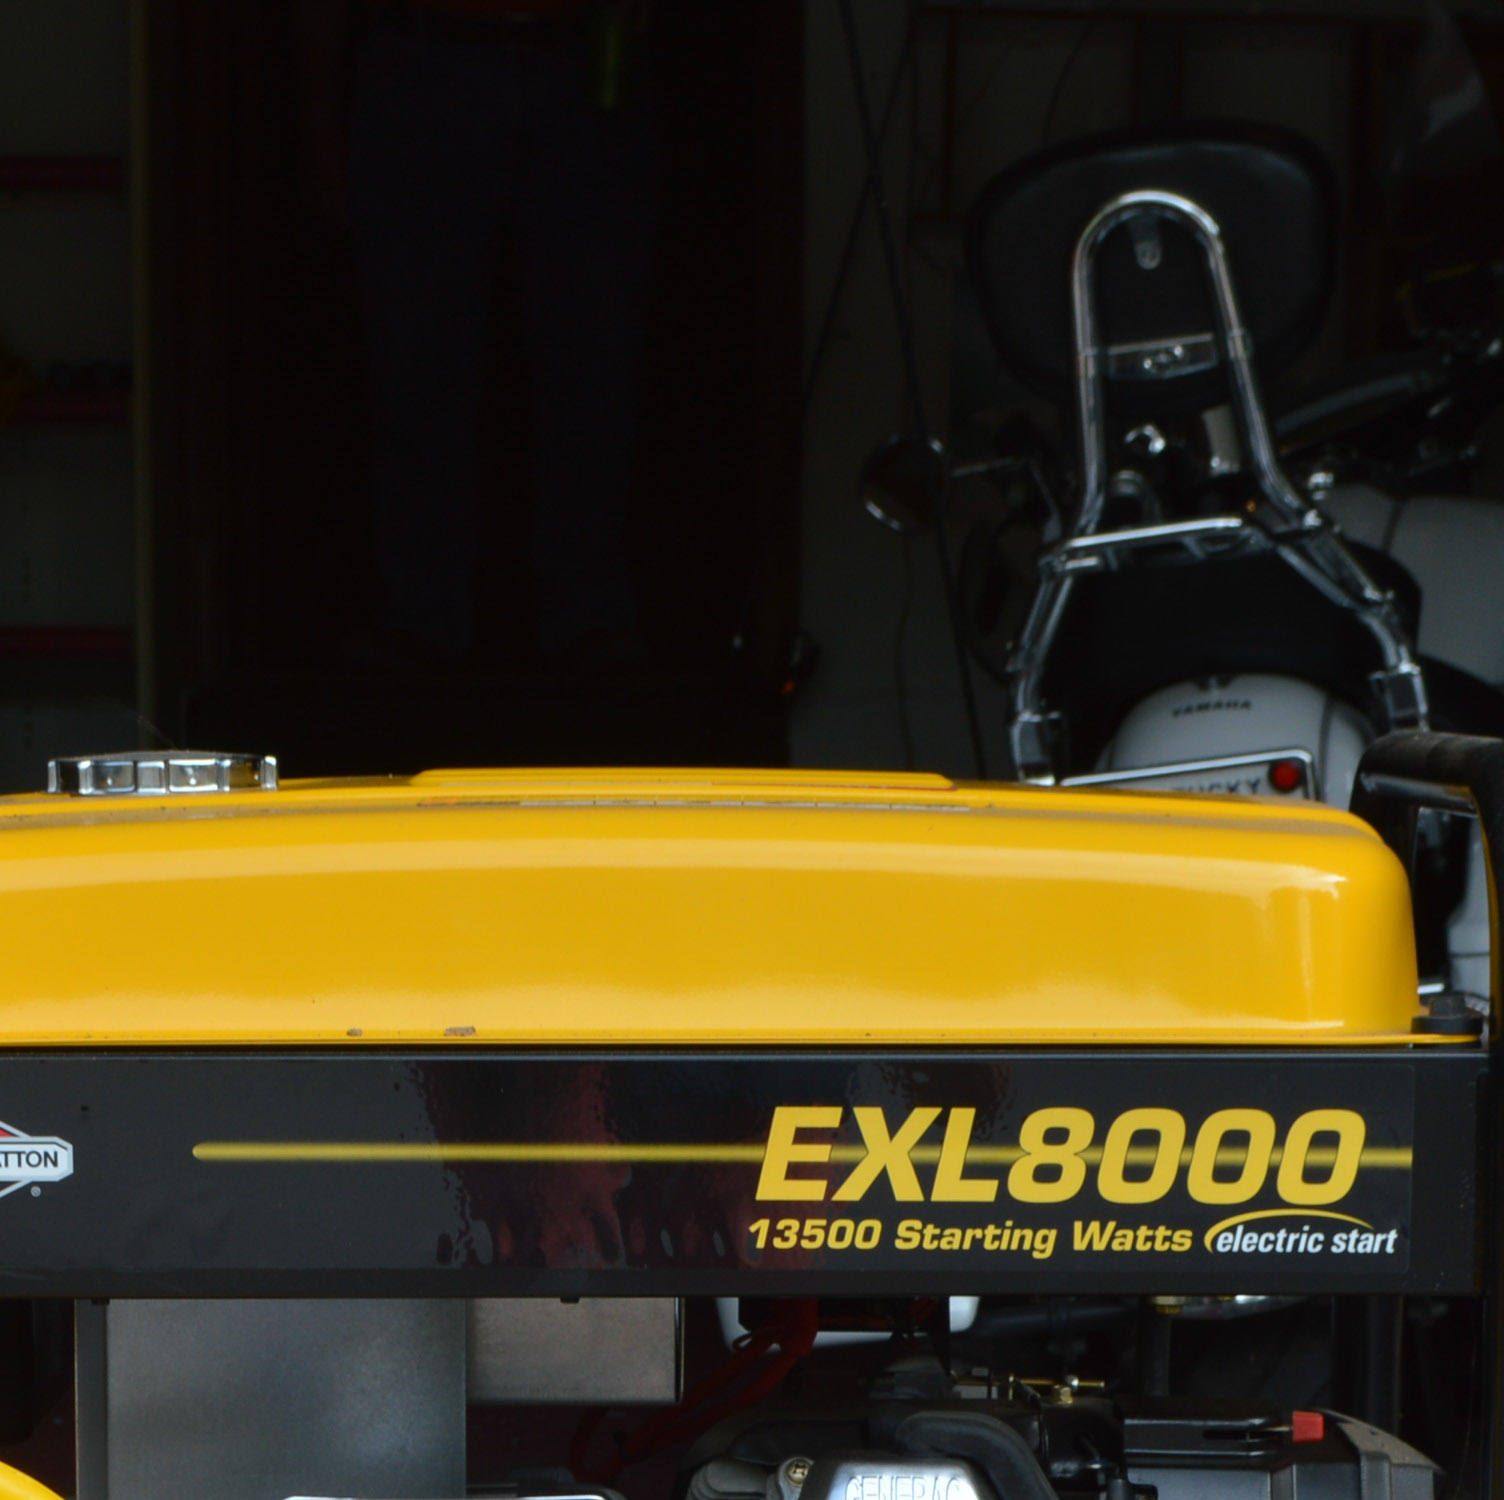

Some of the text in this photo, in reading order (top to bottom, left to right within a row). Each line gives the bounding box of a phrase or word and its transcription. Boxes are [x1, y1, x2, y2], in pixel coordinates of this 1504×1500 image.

[755, 1104, 1366, 1205] EXL8000
[748, 1217, 1398, 1259] 13500 Starting Watts electric start
